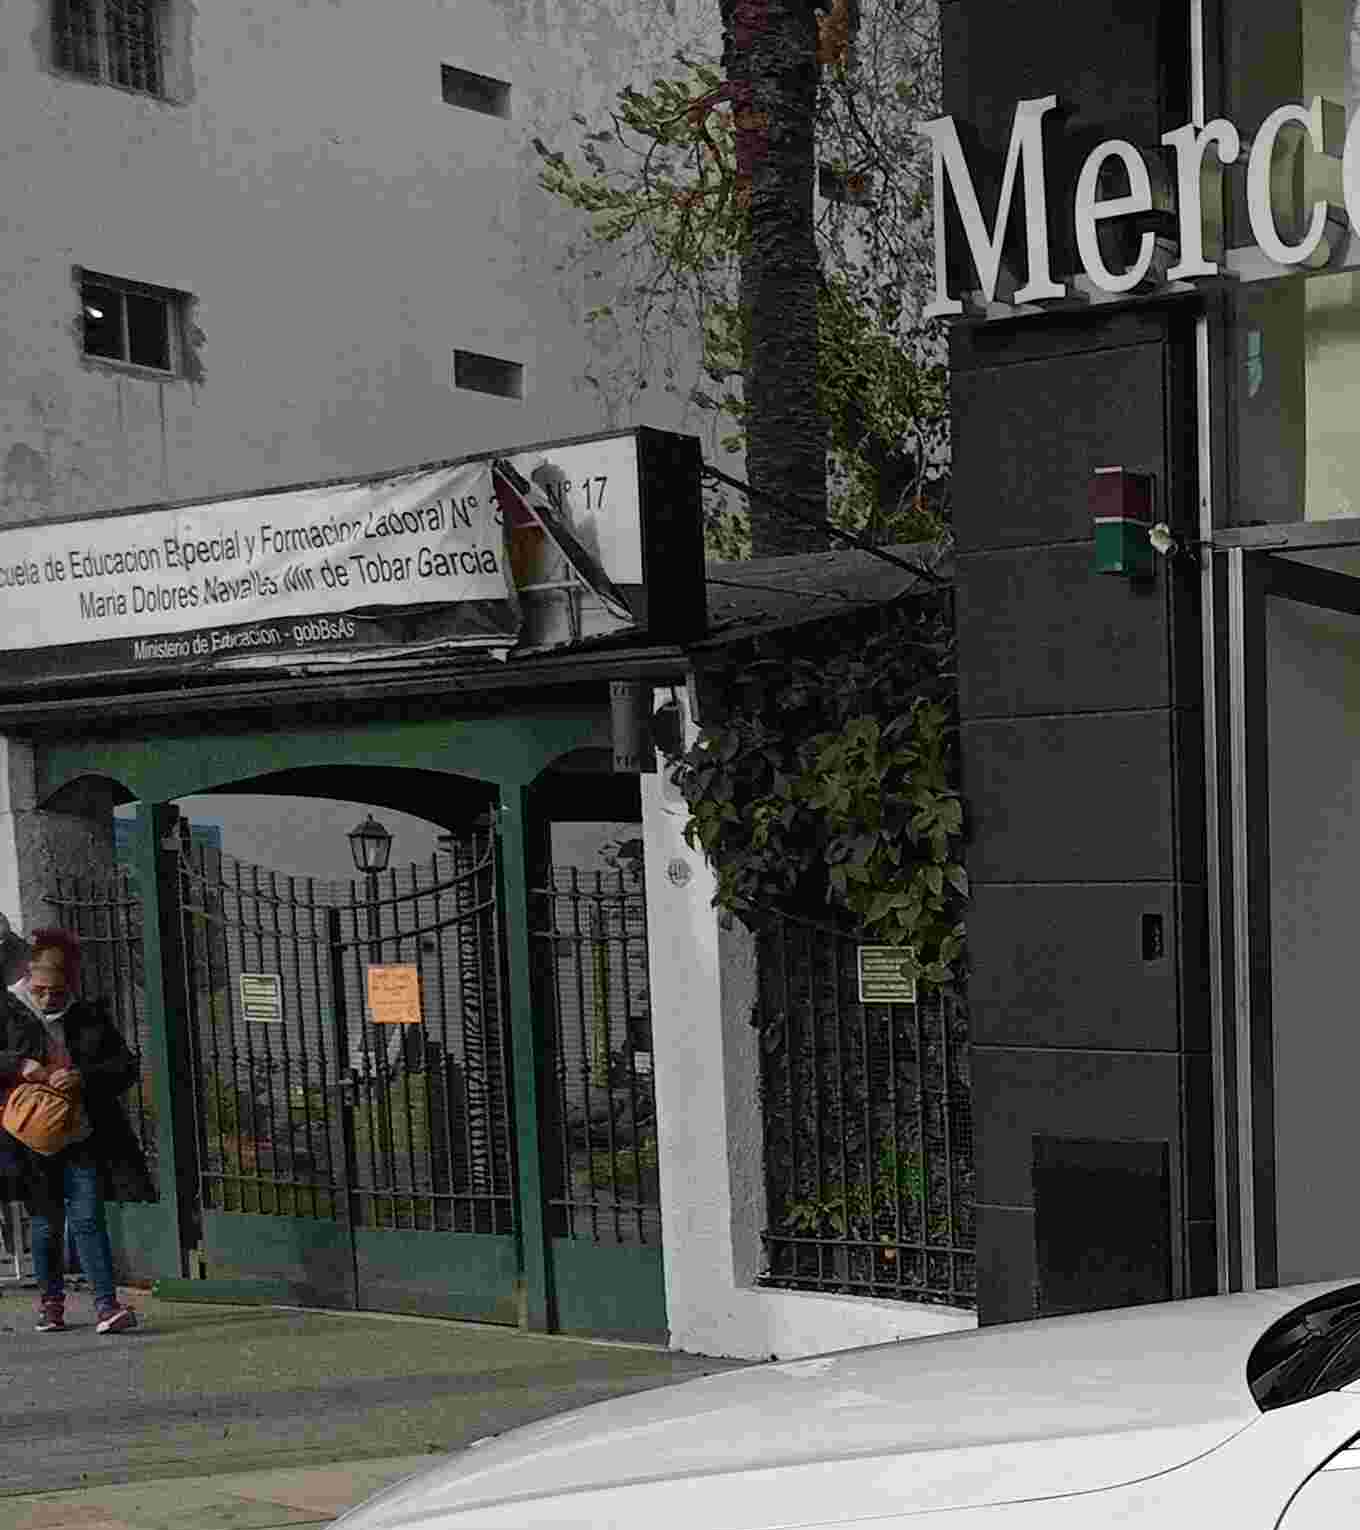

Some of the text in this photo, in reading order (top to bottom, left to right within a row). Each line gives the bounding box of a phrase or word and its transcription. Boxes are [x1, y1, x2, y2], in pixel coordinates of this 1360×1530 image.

[582, 475, 608, 511] 17
[45, 557, 65, 582] de
[164, 530, 241, 571] Epecial
[245, 535, 255, 564] y
[132, 584, 199, 614] Dolores
[321, 559, 349, 588] de
[350, 552, 412, 585] Tobar
[192, 635, 209, 654] de
